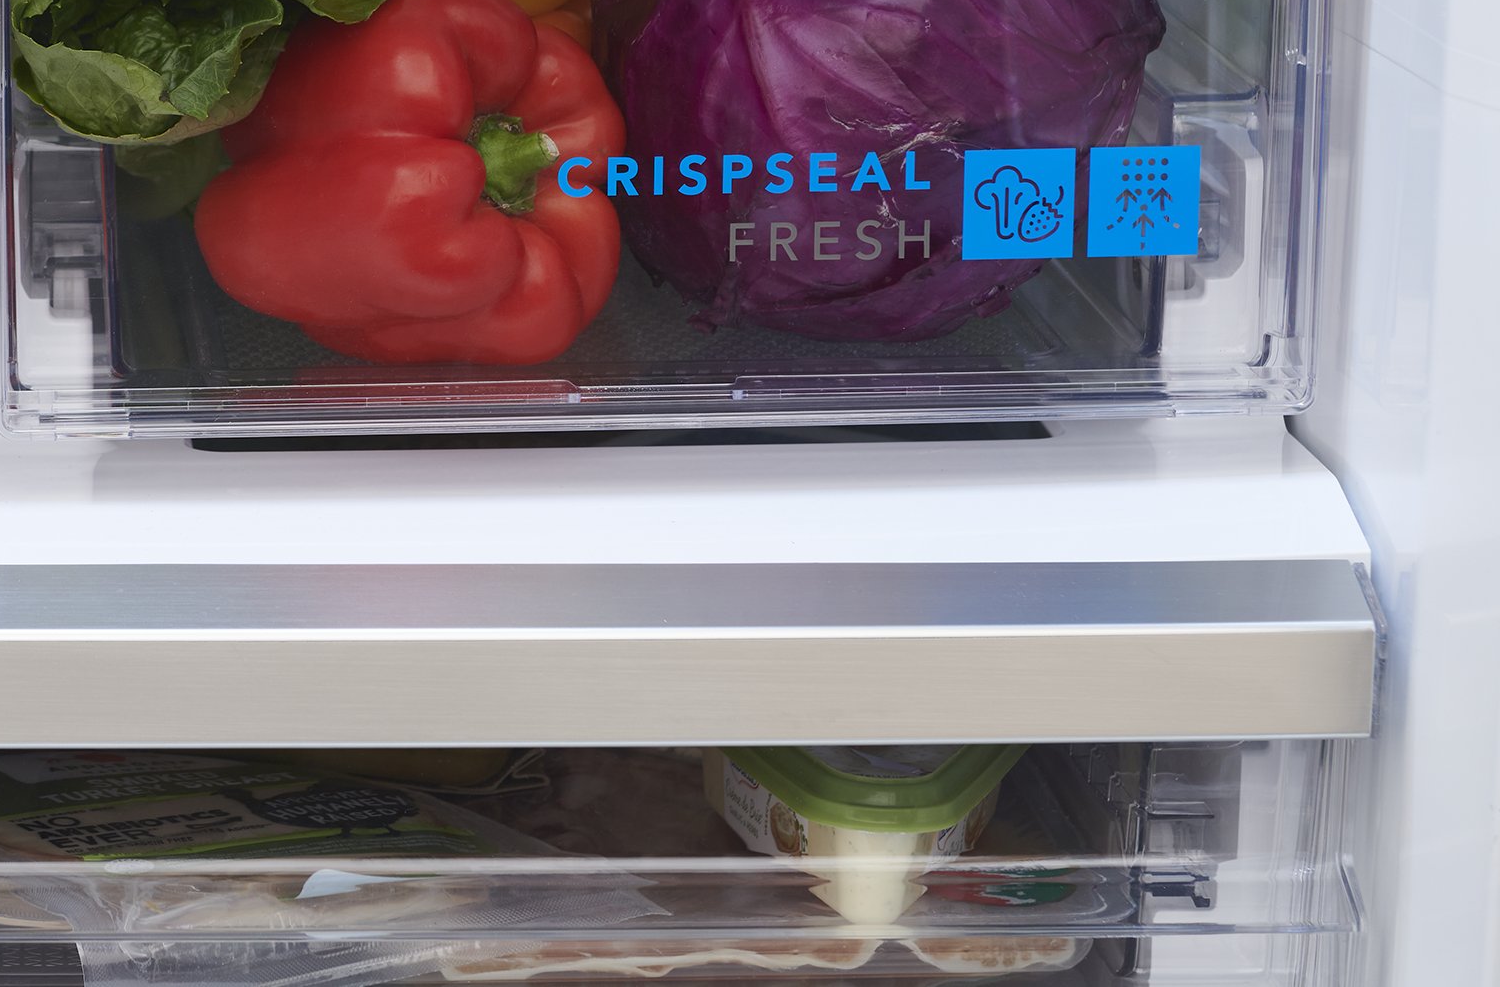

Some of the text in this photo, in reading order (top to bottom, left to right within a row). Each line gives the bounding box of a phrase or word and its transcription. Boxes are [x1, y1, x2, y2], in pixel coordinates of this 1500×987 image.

[557, 151, 931, 198] CRISPSEAL
[728, 219, 931, 263] FRESH
[86, 771, 220, 788] SMOKED
[38, 785, 167, 804] TURKEY
[268, 796, 407, 820] HUMANELY
[16, 816, 81, 832] NO
[38, 809, 231, 840] ANTIBIOTICS
[49, 828, 156, 849] EVER
